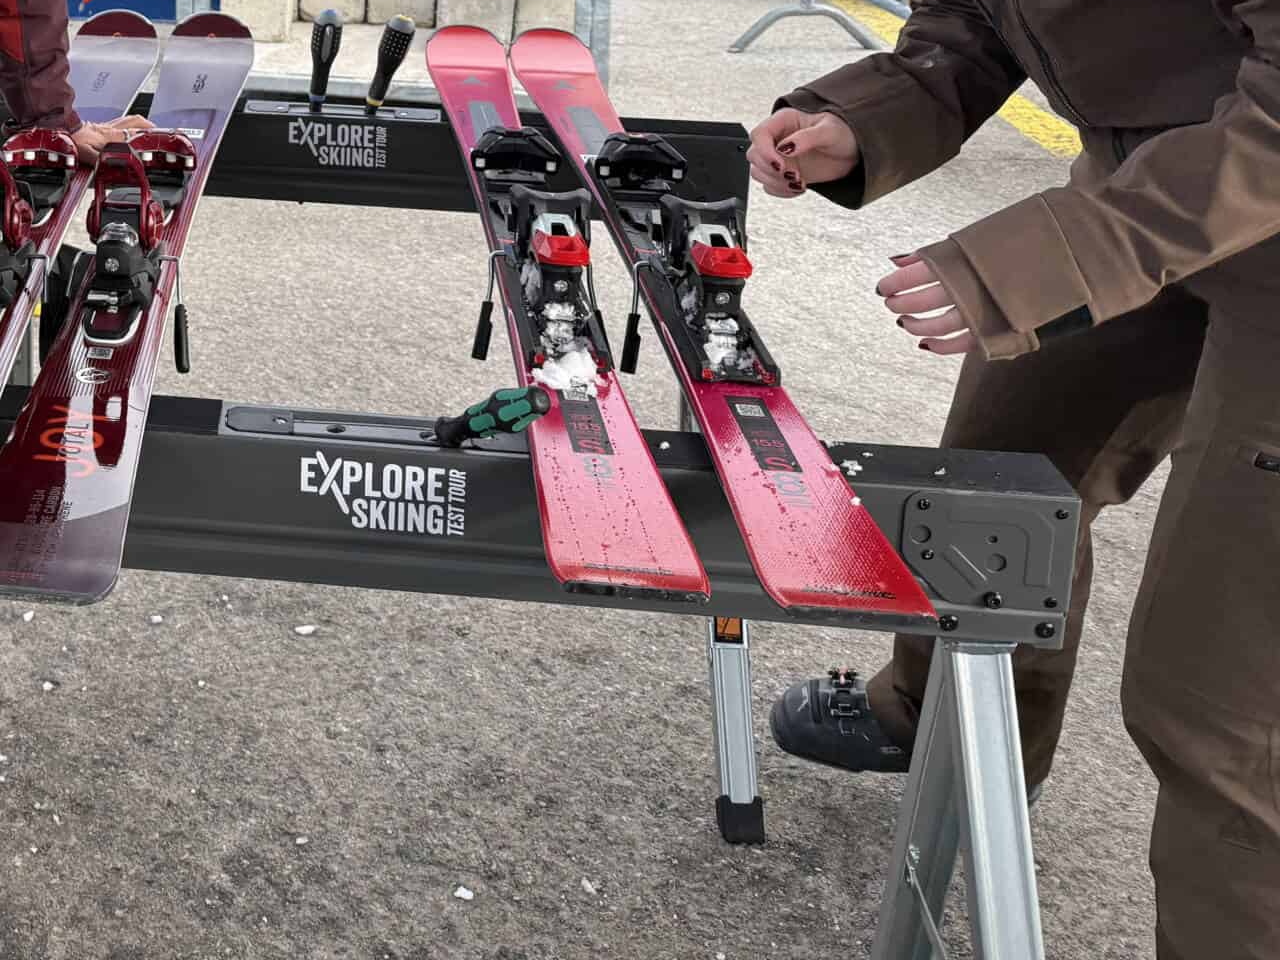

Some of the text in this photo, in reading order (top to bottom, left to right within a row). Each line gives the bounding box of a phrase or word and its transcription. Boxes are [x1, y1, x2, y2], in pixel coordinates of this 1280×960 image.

[287, 117, 375, 157] EXPLORE
[318, 145, 375, 167] SKIING
[32, 403, 114, 479] JOY
[300, 450, 446, 514] EXPLORE
[447, 468, 467, 536] TEST TOUR
[351, 497, 444, 536] SKIING
